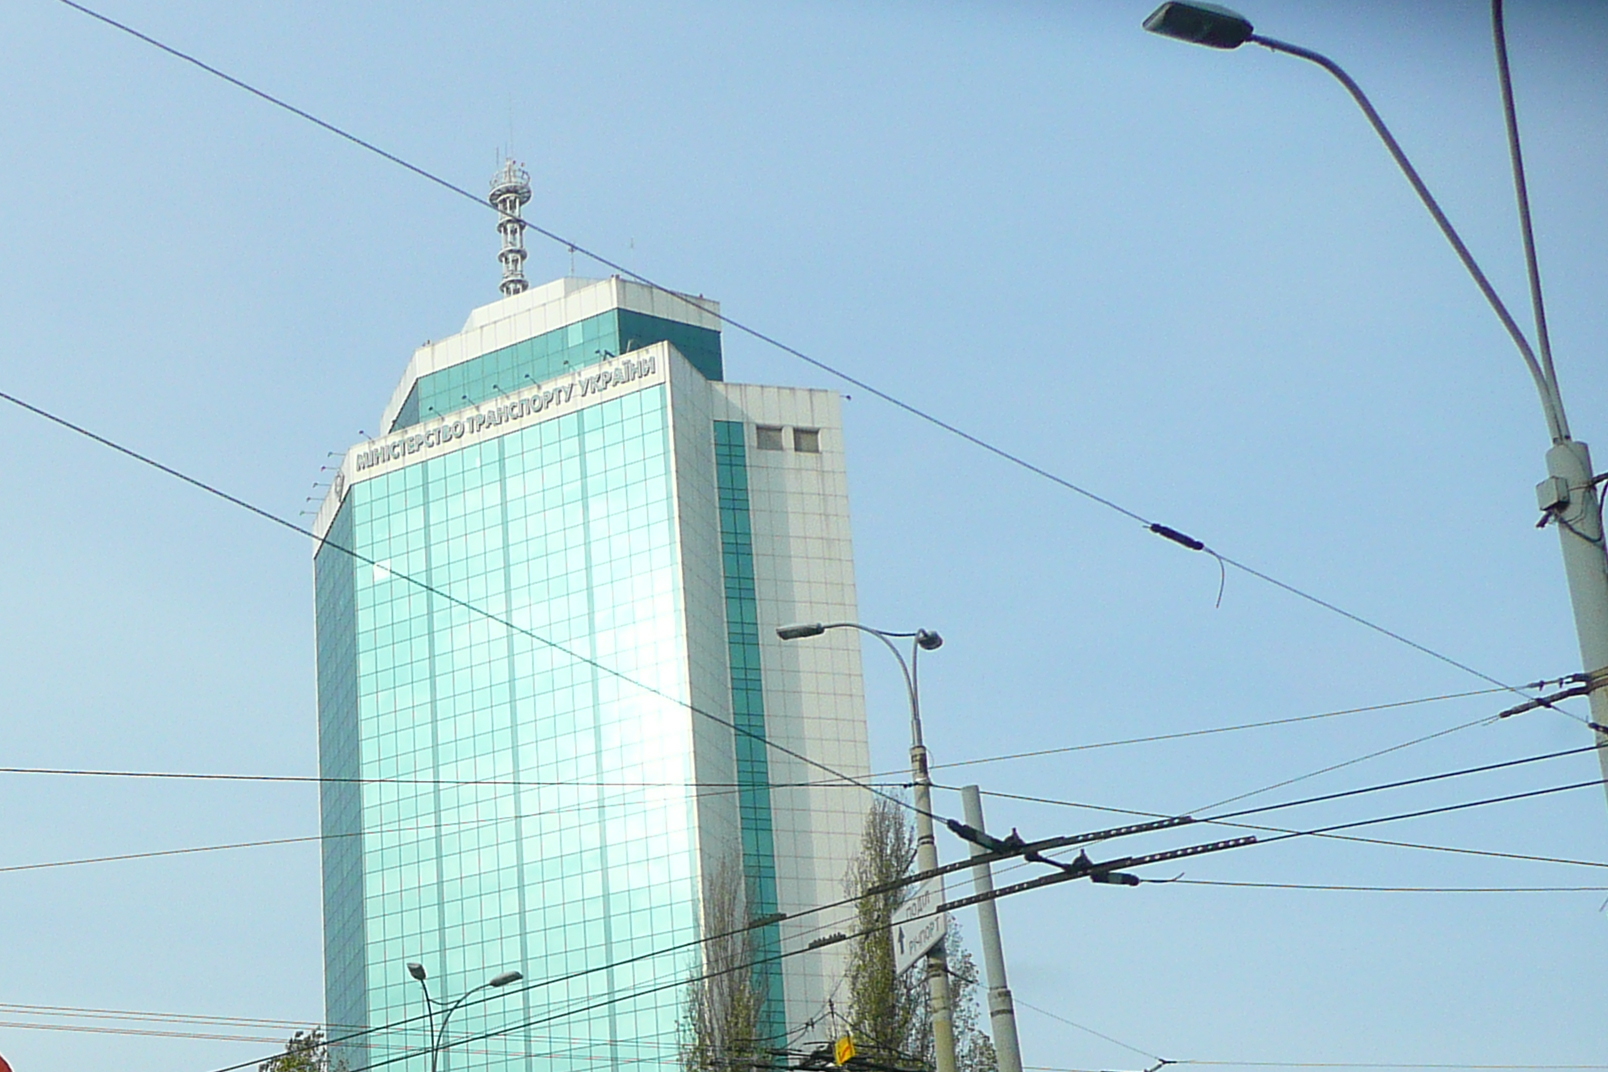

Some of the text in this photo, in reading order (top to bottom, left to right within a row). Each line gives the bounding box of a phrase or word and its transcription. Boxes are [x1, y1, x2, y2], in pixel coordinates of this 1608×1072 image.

[355, 356, 656, 472] МІНІСТЕРСТВО ТРАНСПОРТУ УКРАЇНИ
